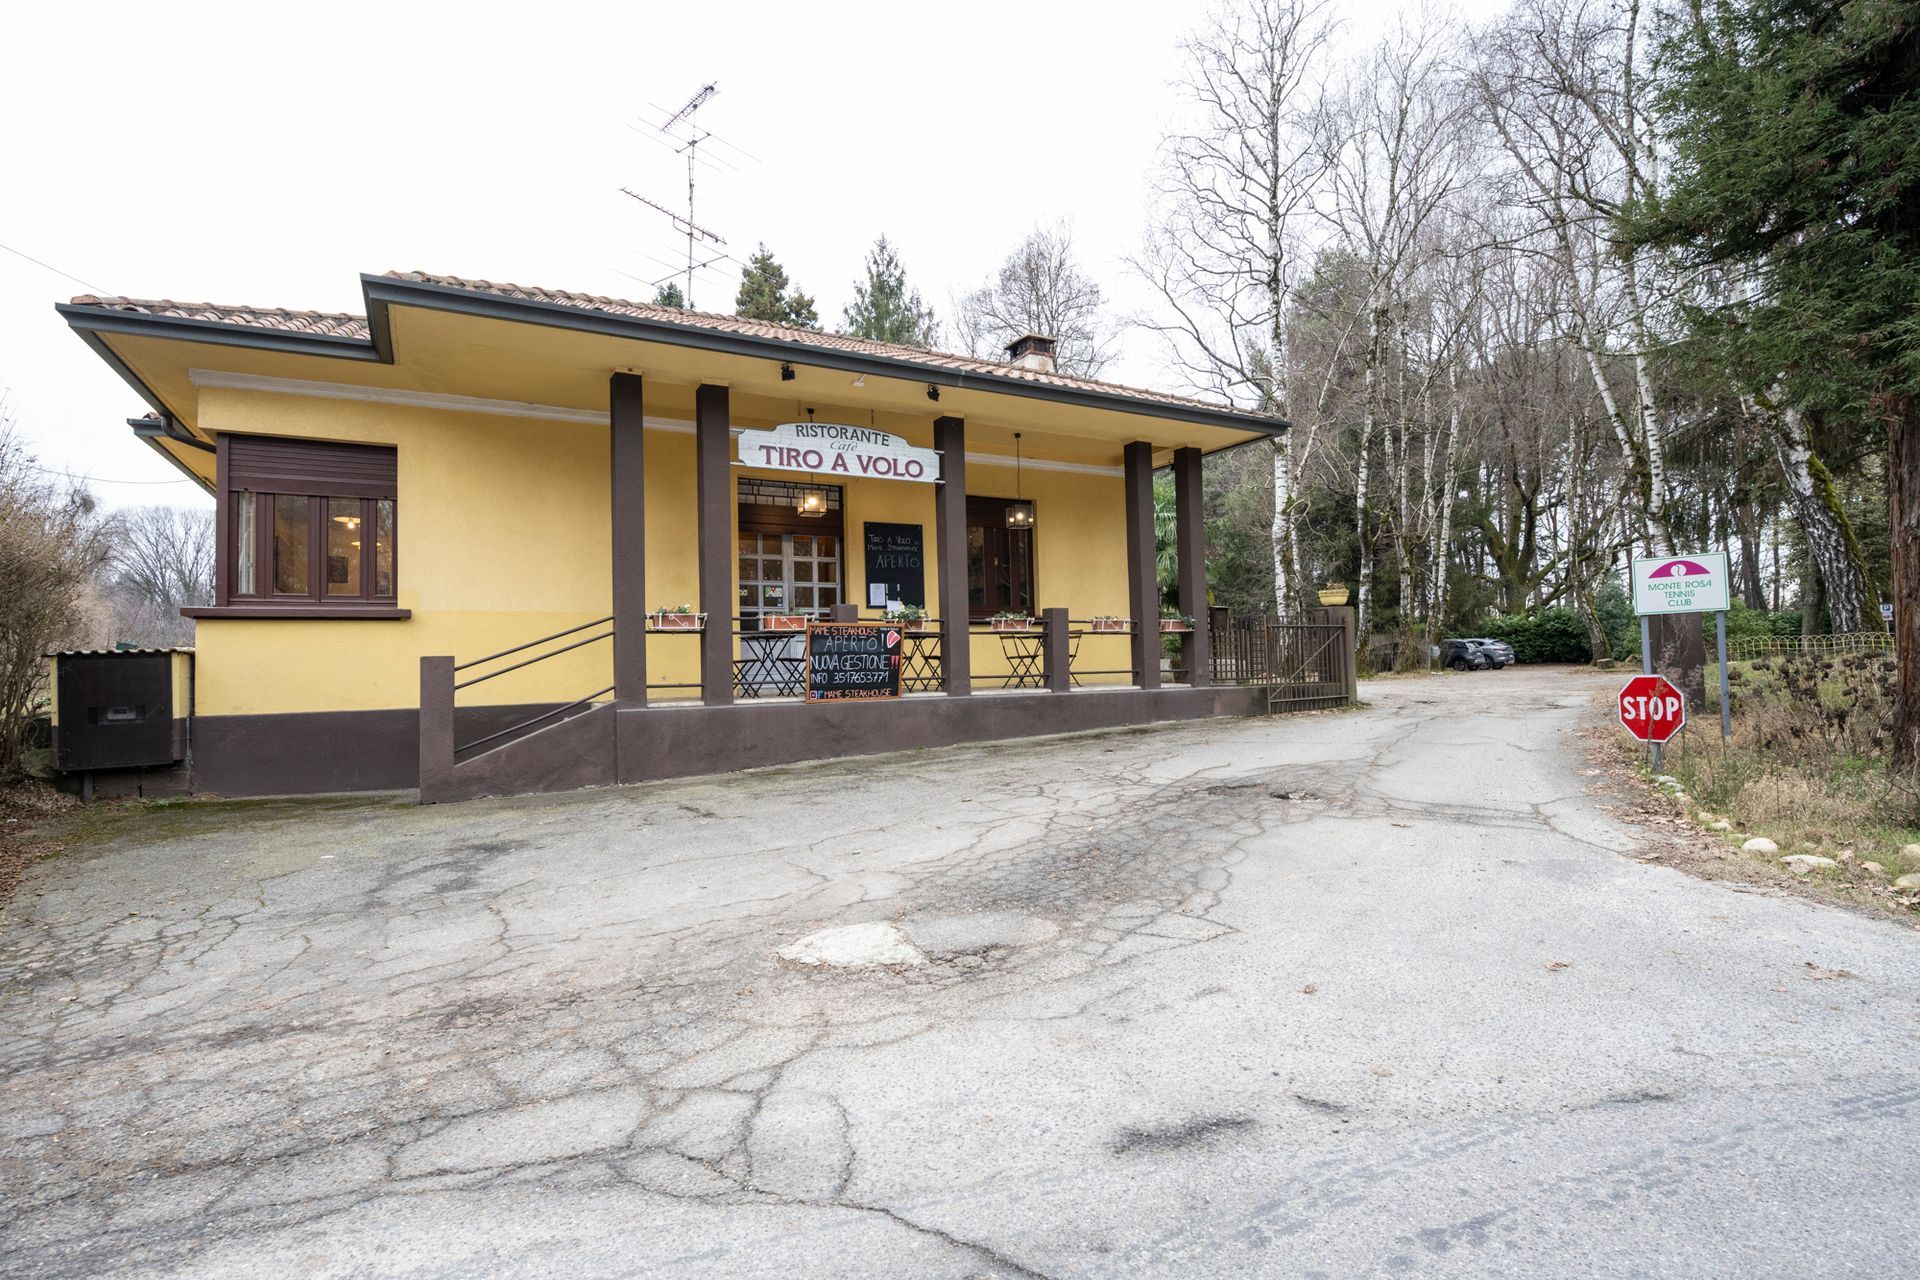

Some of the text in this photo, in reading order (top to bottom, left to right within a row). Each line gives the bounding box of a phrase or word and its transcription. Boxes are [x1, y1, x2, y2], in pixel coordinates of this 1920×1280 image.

[795, 424, 890, 447] RISTORANTE
[758, 445, 924, 479] TIRO A VOLO
[1648, 580, 1712, 591] MONTE ROSA
[1664, 590, 1695, 599] TENNIS
[1668, 598, 1692, 607] CLUB
[809, 626, 878, 636] MAME STEAKHOUSE
[810, 654, 839, 670] NUOVA
[810, 672, 828, 684] INFO
[824, 688, 892, 698] MAME STEAKHOUSE
[1623, 696, 1679, 721] STOP
